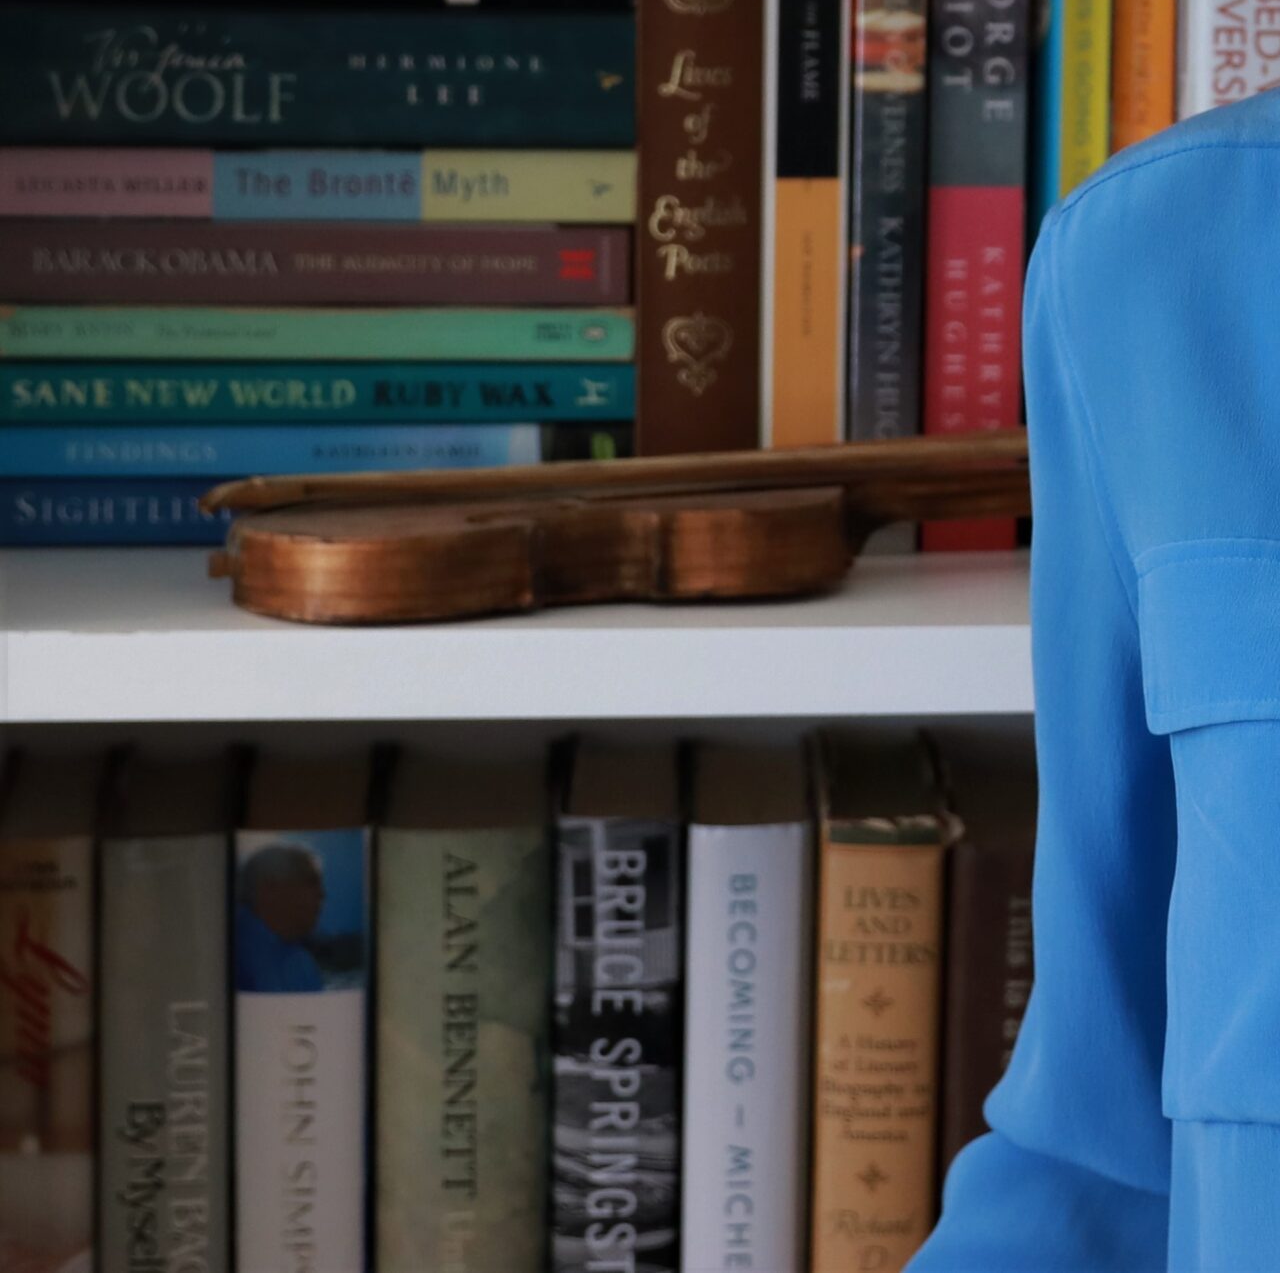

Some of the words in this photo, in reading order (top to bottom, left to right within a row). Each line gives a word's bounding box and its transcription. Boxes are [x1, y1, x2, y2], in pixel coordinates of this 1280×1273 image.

[347, 52, 546, 77] HERMIONE
[47, 70, 298, 124] WOOLF
[404, 81, 486, 107] LEE
[234, 167, 293, 198] The
[431, 167, 510, 203] Myth
[31, 246, 157, 276] BARACK
[157, 246, 280, 276] OBAMA
[876, 216, 903, 364] KATHRYN
[940, 257, 968, 431] HUGHES
[10, 378, 113, 408] SANE
[123, 378, 220, 409] NEW
[227, 379, 357, 410] WORLD
[371, 379, 466, 409] RUBY
[476, 381, 555, 410] WAX
[64, 440, 218, 465] FINDINGS
[440, 852, 479, 975] ALAN
[843, 885, 923, 910] LIVES
[590, 849, 647, 1017] BRUCE
[853, 915, 913, 935] AND
[725, 872, 756, 1085] BECOMING
[166, 999, 209, 1184] LAUREN
[280, 1023, 318, 1147] JOHN
[440, 991, 479, 1201] BENNETT
[114, 1099, 167, 1151] By
[722, 1143, 755, 1272] MICHE
